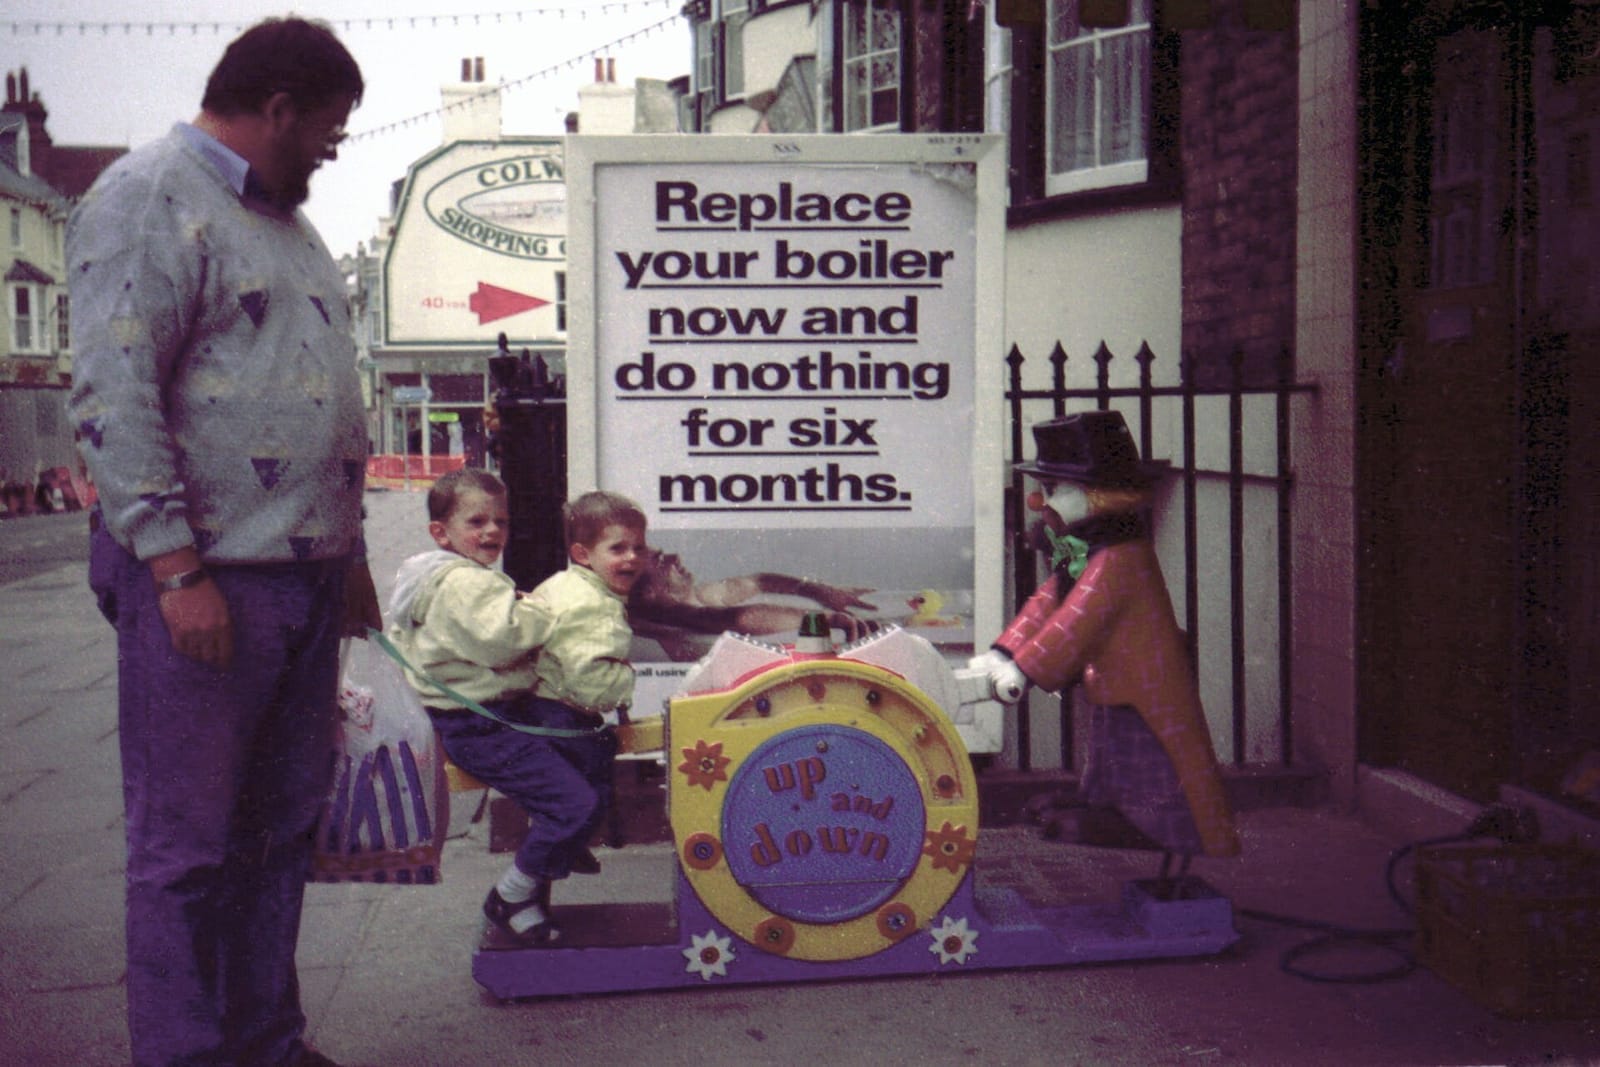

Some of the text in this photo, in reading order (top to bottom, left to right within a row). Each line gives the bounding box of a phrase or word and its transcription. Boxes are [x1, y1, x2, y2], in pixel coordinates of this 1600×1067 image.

[655, 181, 911, 231] Replace
[440, 208, 548, 256] SHOPPING
[615, 239, 955, 289] your boiler
[421, 297, 444, 308] 40
[649, 296, 918, 335] now and
[615, 352, 950, 399] do nothing
[681, 408, 878, 447] for six
[659, 464, 911, 501] months.
[763, 756, 827, 800] up
[830, 792, 894, 820] and
[750, 823, 889, 867] down
